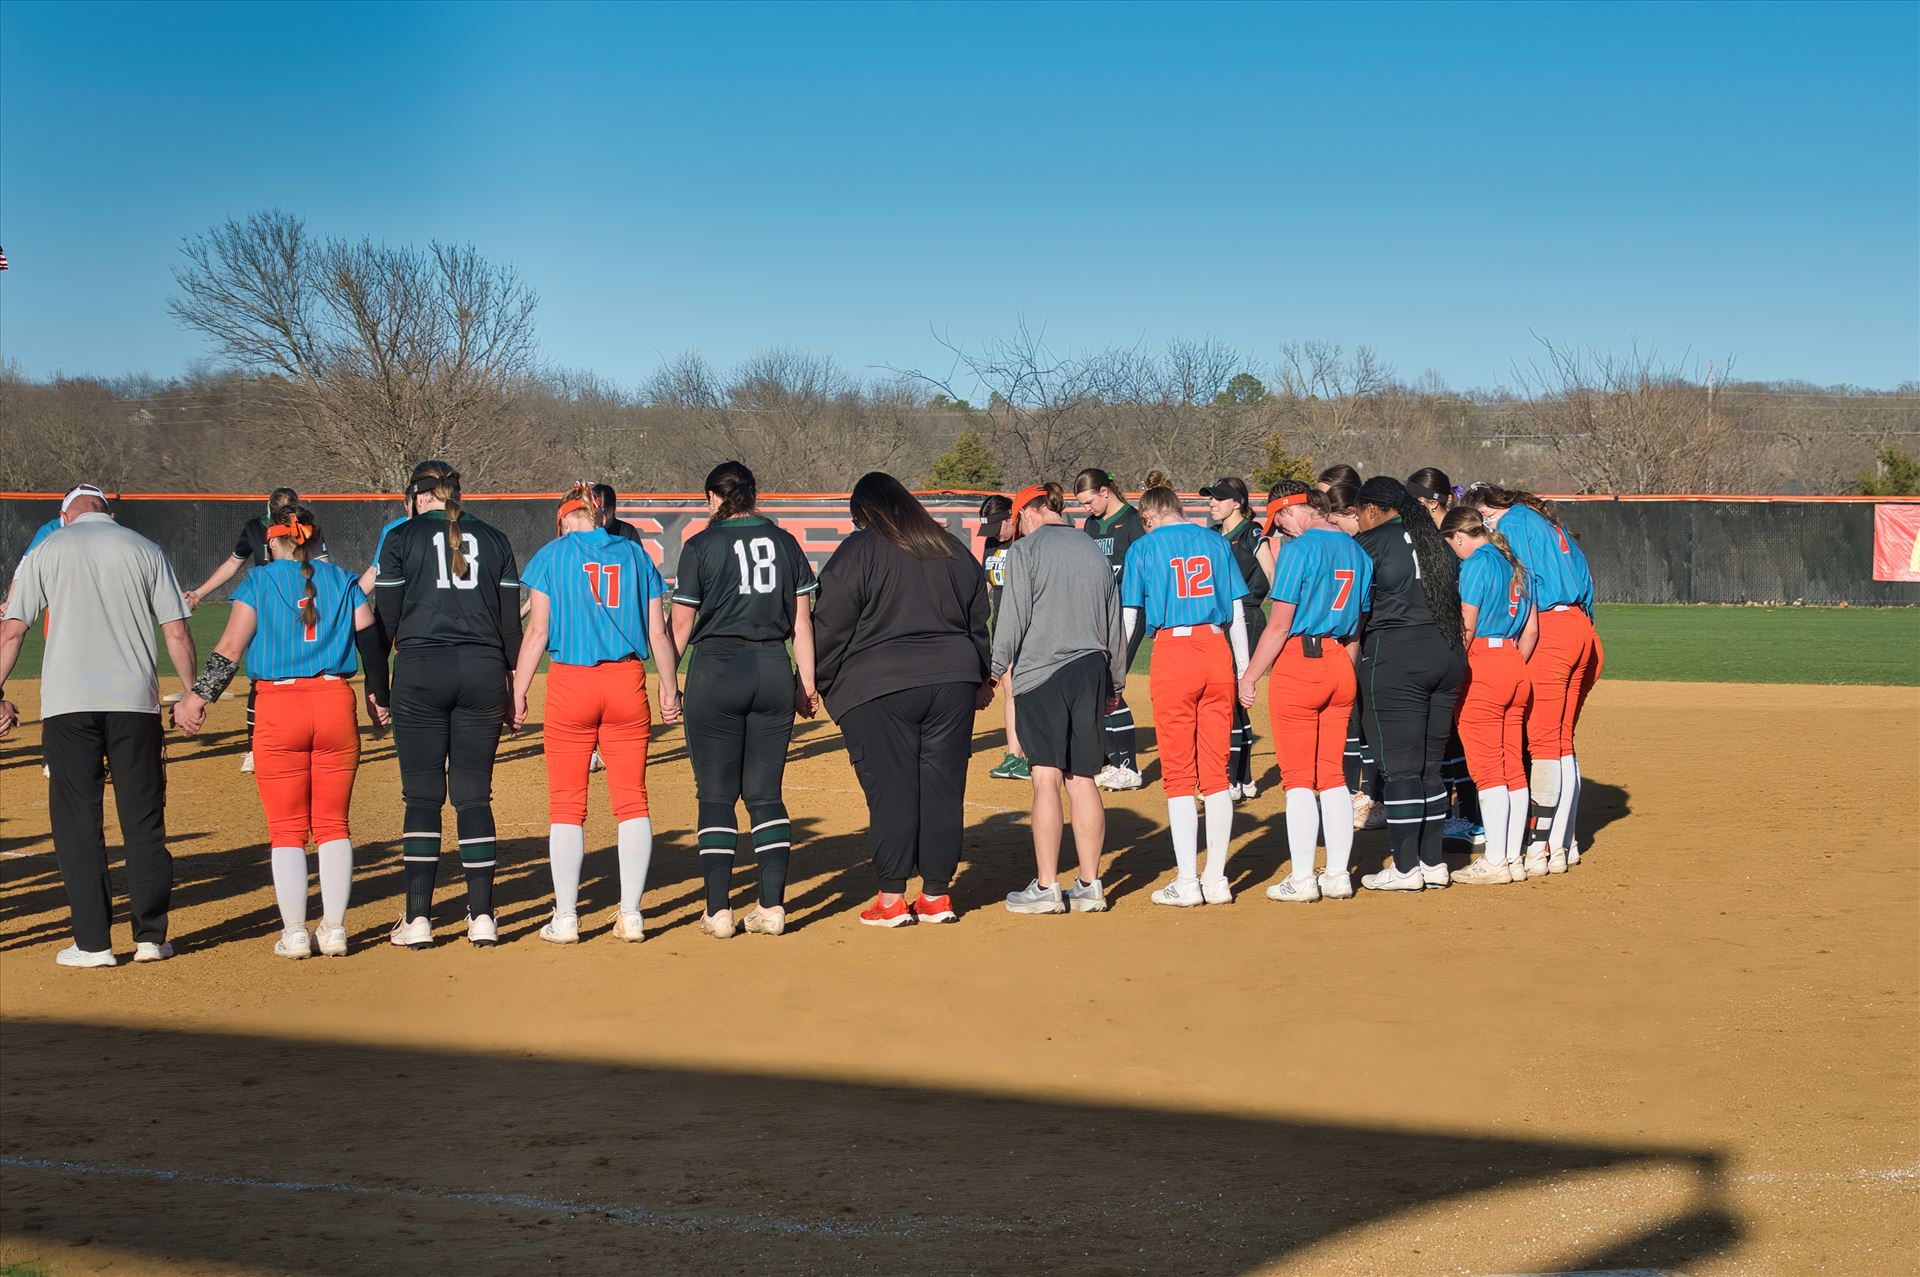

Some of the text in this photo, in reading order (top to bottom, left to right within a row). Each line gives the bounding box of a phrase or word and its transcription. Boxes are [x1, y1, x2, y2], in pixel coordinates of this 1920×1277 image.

[583, 562, 620, 608] 11
[733, 537, 776, 594] 18
[1170, 555, 1214, 598] 12
[1331, 570, 1355, 610] 7
